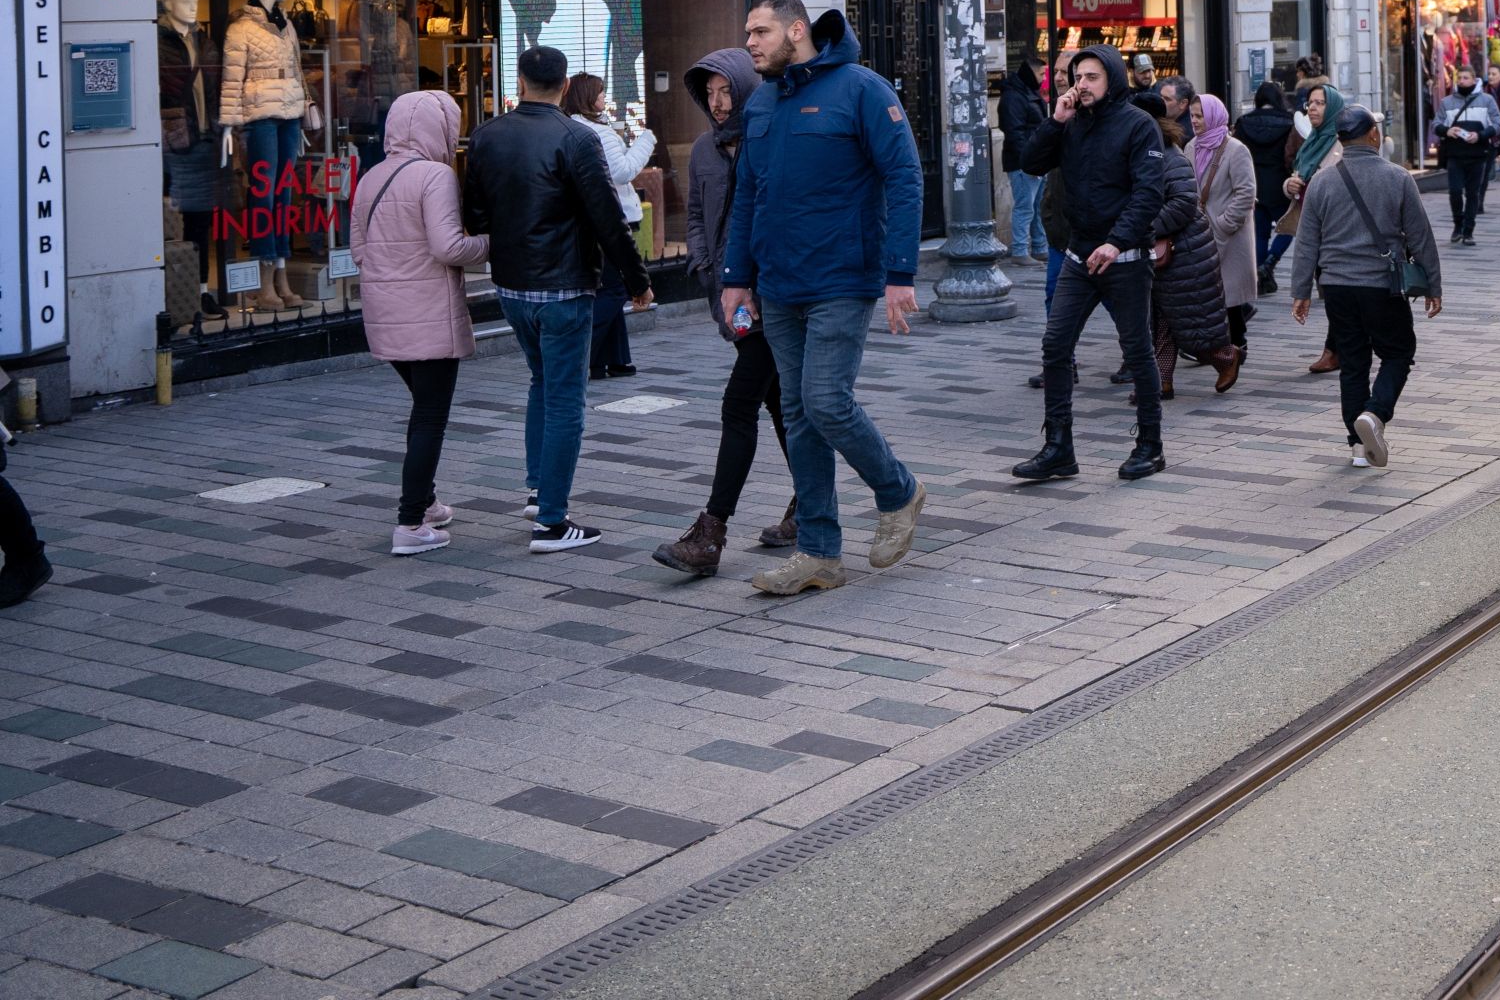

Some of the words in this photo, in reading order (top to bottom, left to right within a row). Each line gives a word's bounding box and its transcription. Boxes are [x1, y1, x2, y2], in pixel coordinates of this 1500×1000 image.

[251, 157, 341, 198] SALE
[38, 130, 54, 325] CAMBIO
[212, 201, 340, 240] İNDİRİM
